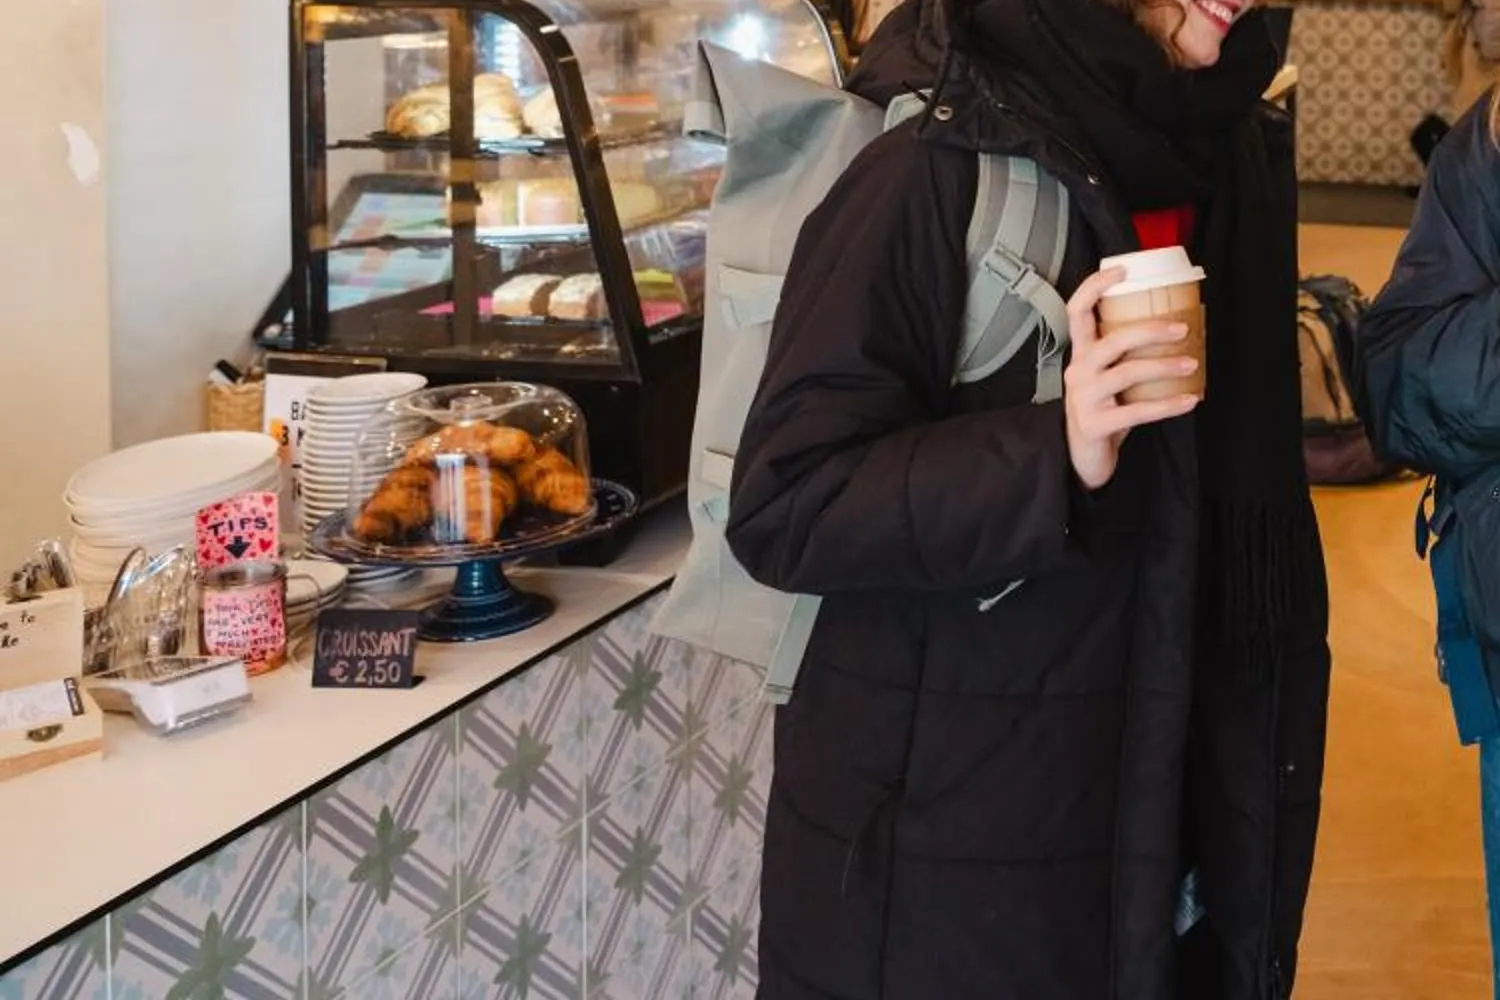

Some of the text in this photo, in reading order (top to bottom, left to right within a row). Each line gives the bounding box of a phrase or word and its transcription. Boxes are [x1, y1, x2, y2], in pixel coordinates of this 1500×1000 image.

[207, 516, 268, 537] TIPS
[317, 627, 417, 658] CROISSANT
[354, 658, 402, 686] 2,50
